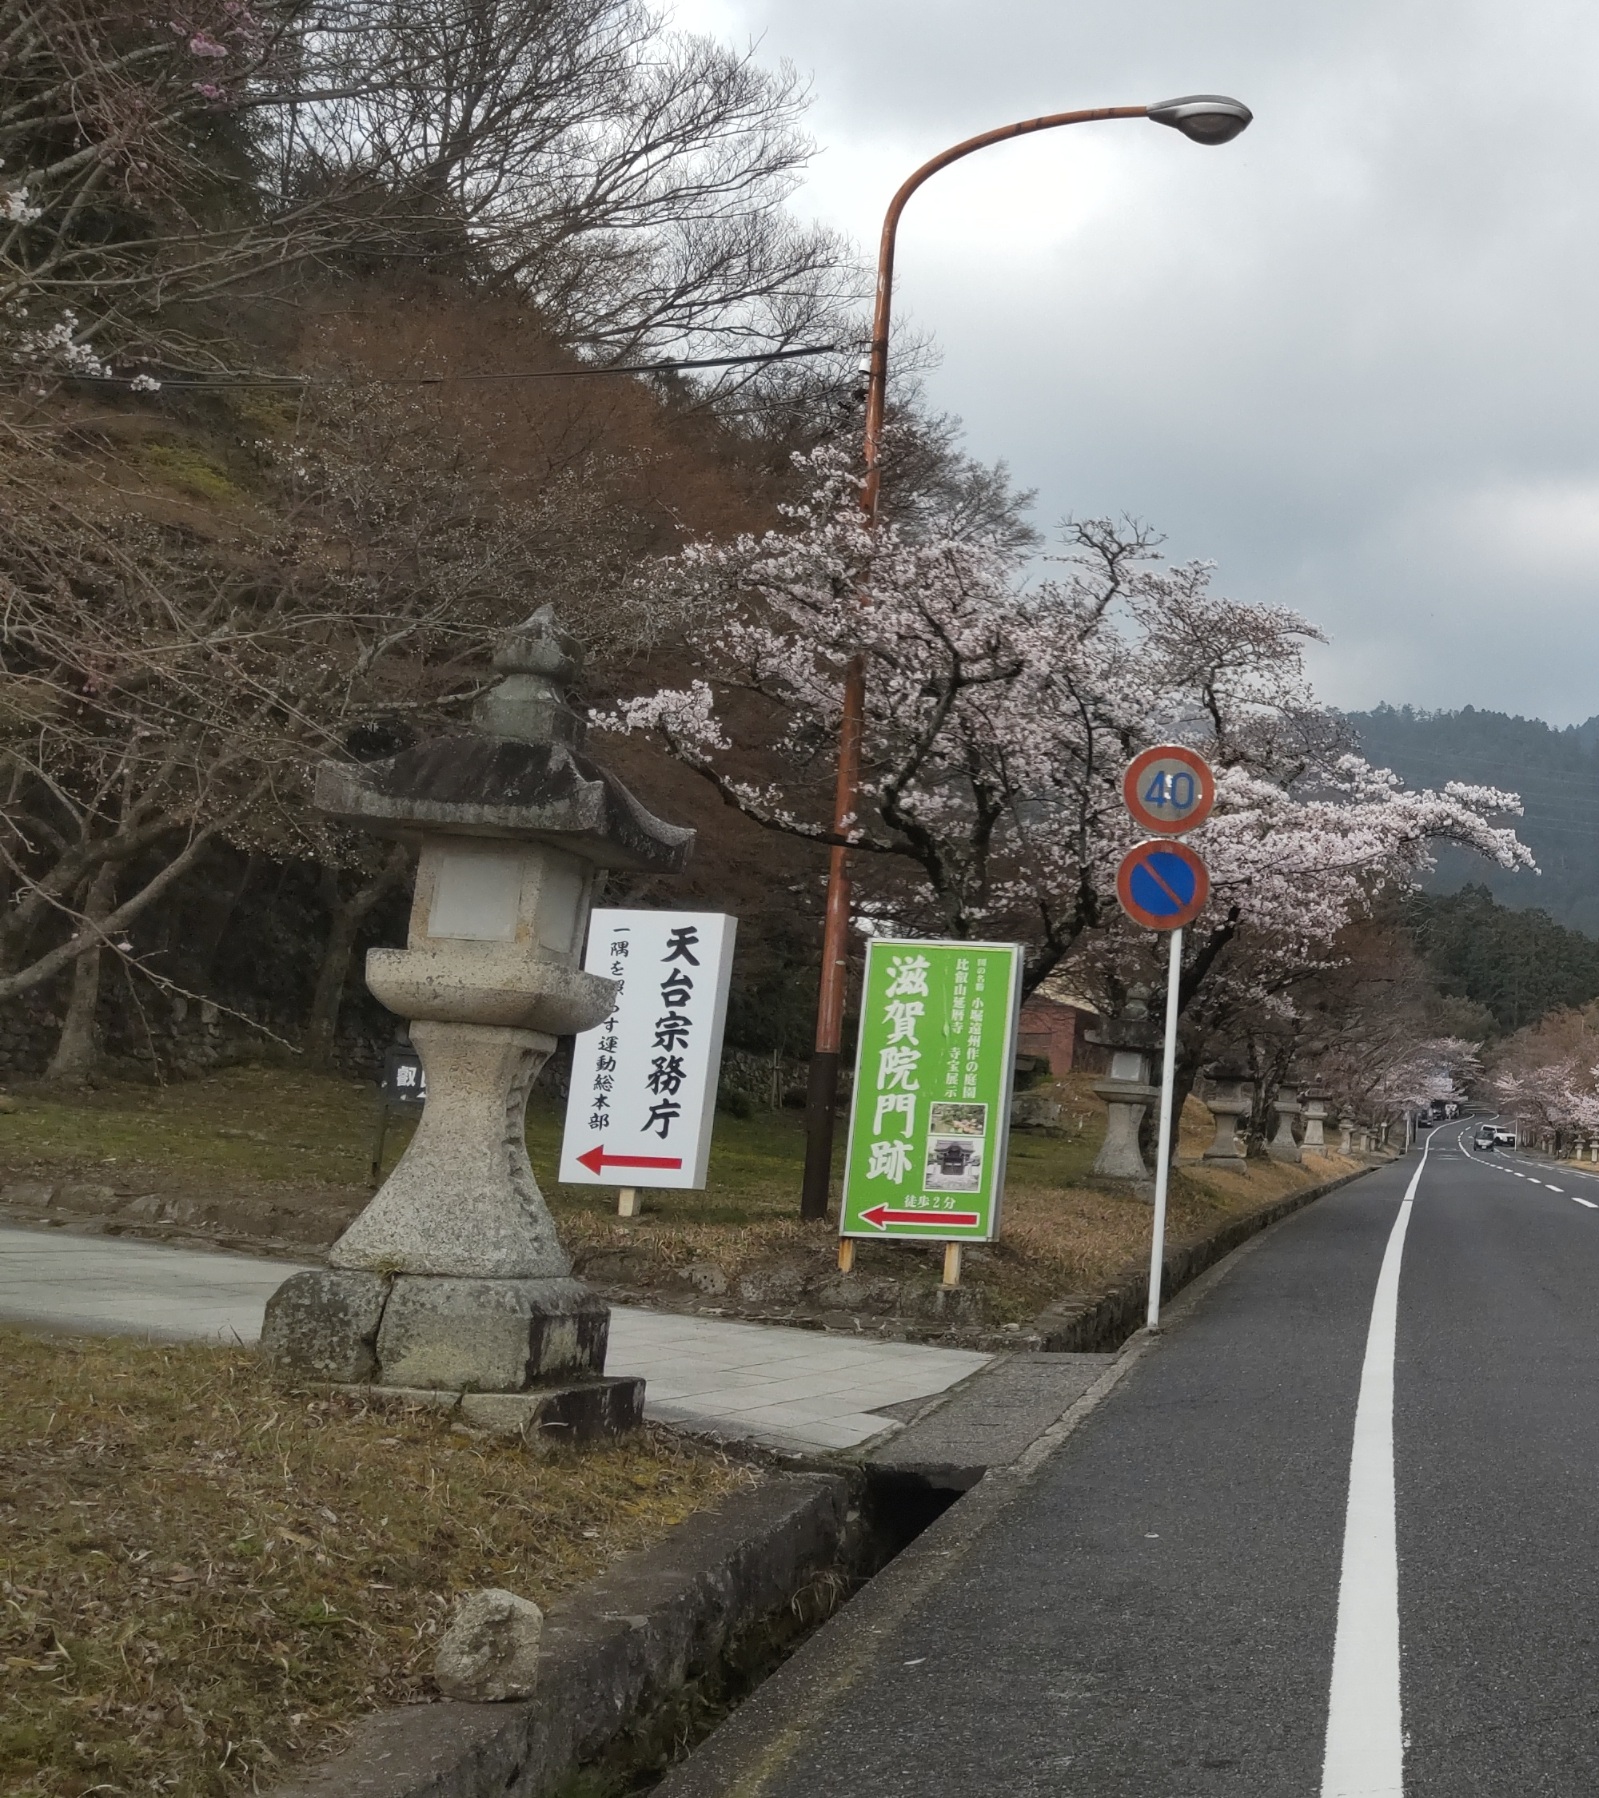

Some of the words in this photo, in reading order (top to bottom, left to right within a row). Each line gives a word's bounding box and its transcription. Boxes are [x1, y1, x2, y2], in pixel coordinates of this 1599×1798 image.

[1144, 770, 1195, 810] 40
[640, 925, 701, 1140] 天台宗務庁
[951, 958, 970, 1035] 比叡山延暦寺
[865, 954, 931, 1185] 滋賀院門跡
[944, 1046, 961, 1098] 寺宝展示
[962, 997, 984, 1099] 小堀遠州作の庭園
[903, 1193, 957, 1211] 徒歩2分
